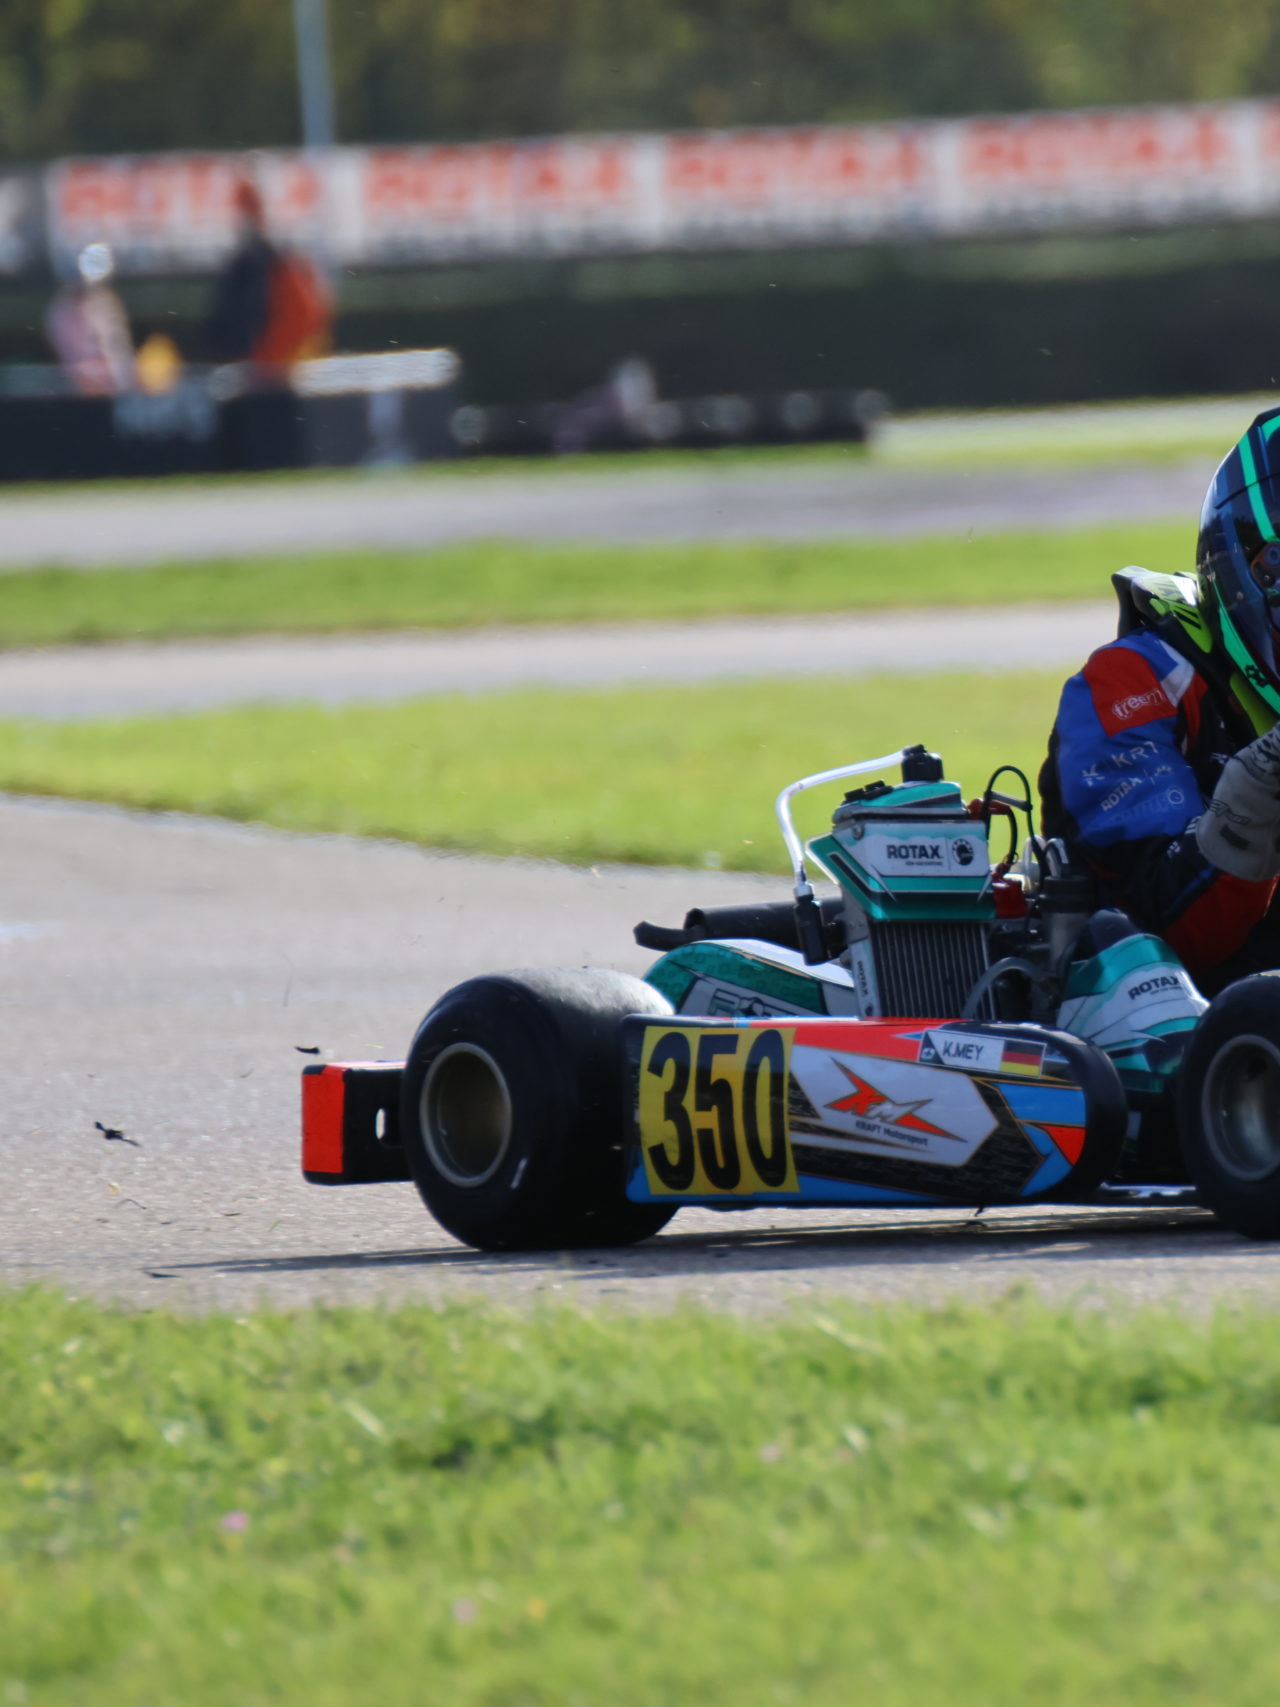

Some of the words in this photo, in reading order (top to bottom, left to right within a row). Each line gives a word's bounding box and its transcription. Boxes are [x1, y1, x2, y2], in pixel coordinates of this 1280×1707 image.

[1112, 688, 1166, 720] freem
[886, 844, 941, 860] ROTAX
[856, 960, 870, 997] ROTAX
[1128, 976, 1180, 1001] ROTAX
[942, 1040, 985, 1061] K.MEY
[647, 1028, 788, 1191] 350
[855, 1118, 883, 1134] KRAFT
[883, 1125, 929, 1147] Motorsport
